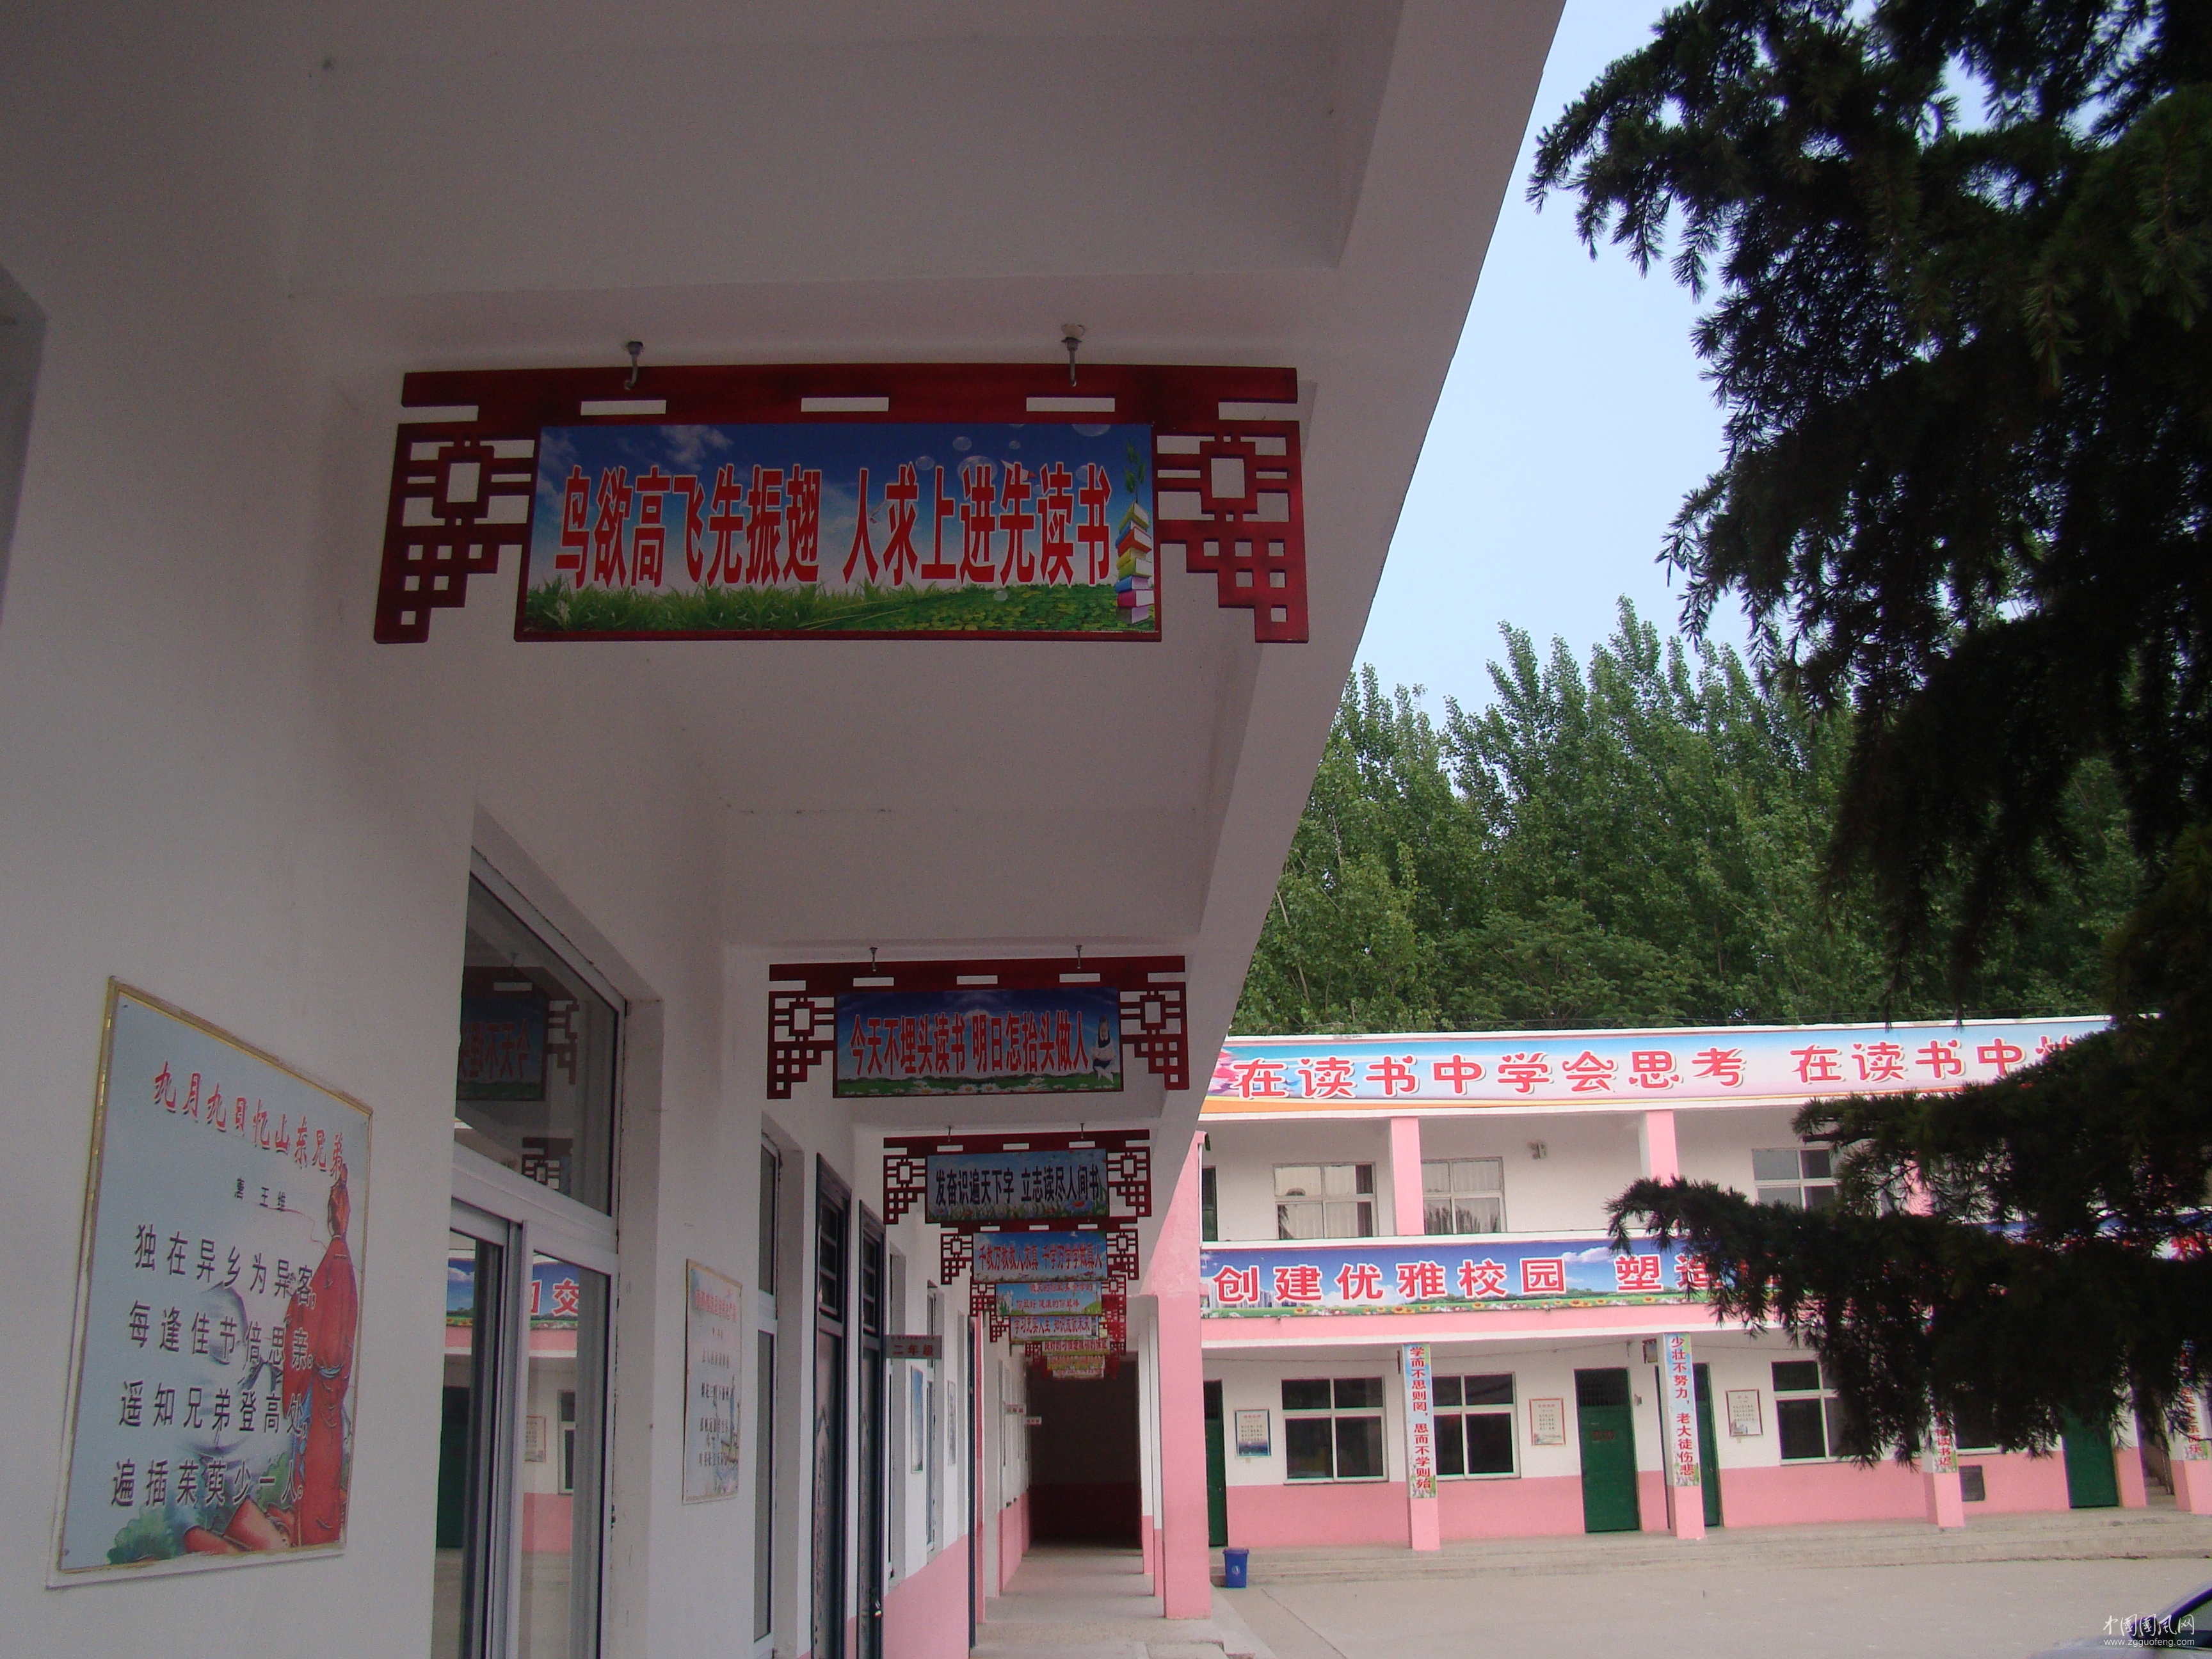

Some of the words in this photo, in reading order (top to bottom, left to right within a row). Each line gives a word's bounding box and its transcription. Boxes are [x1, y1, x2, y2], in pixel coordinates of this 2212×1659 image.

[554, 462, 822, 590] 鸟欲高飞先振翅
[841, 460, 1114, 588] 人求上进先读书
[849, 1011, 966, 1077] 今天不埋头读书
[970, 1009, 1088, 1074] 明日怎抬头做人
[1232, 1048, 1745, 1099] 在读书中学会思考
[154, 1061, 344, 1180] 九月九日忆山东兄弟
[259, 1187, 286, 1212] 王维
[936, 1167, 1014, 1206] 发奋识遍天下字
[1022, 1163, 1100, 1202] 立志读尽人间书
[1213, 1256, 1567, 1305] 创建优雅校园
[129, 1300, 313, 1371] 每逢佳节倍思亲。
[893, 1344, 934, 1356] 二年级
[111, 1457, 304, 1506] 遍插茱萸少一人。
